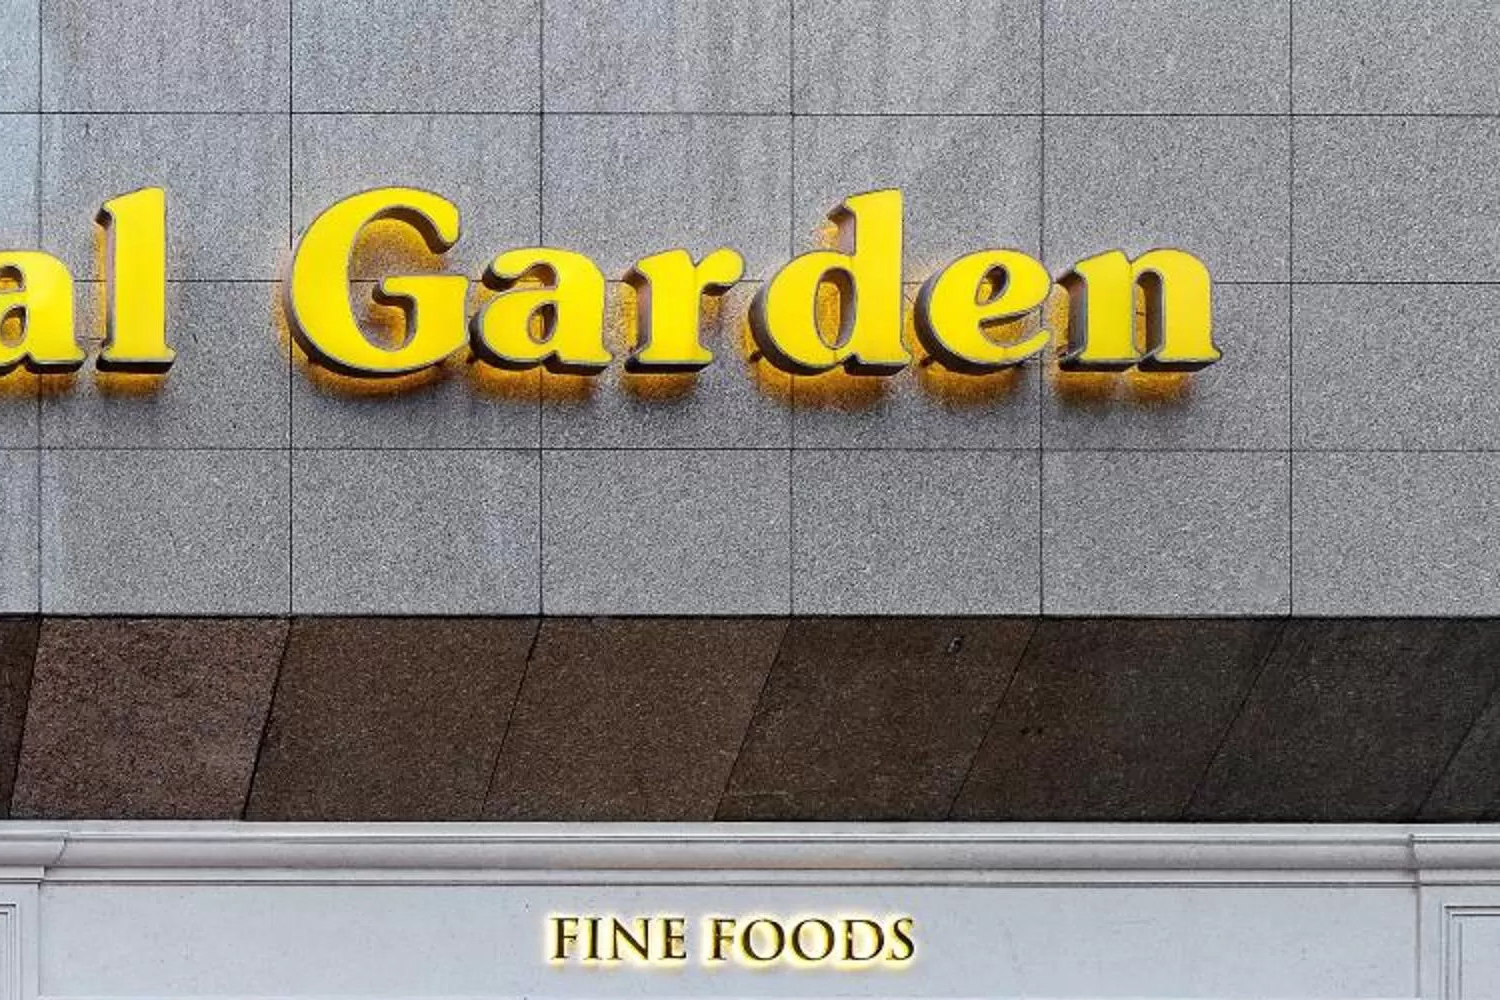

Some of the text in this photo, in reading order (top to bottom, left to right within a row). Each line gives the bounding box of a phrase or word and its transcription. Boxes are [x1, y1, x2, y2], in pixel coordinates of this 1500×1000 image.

[288, 186, 1223, 376] Garden
[550, 917, 915, 961] FINE FOODS
